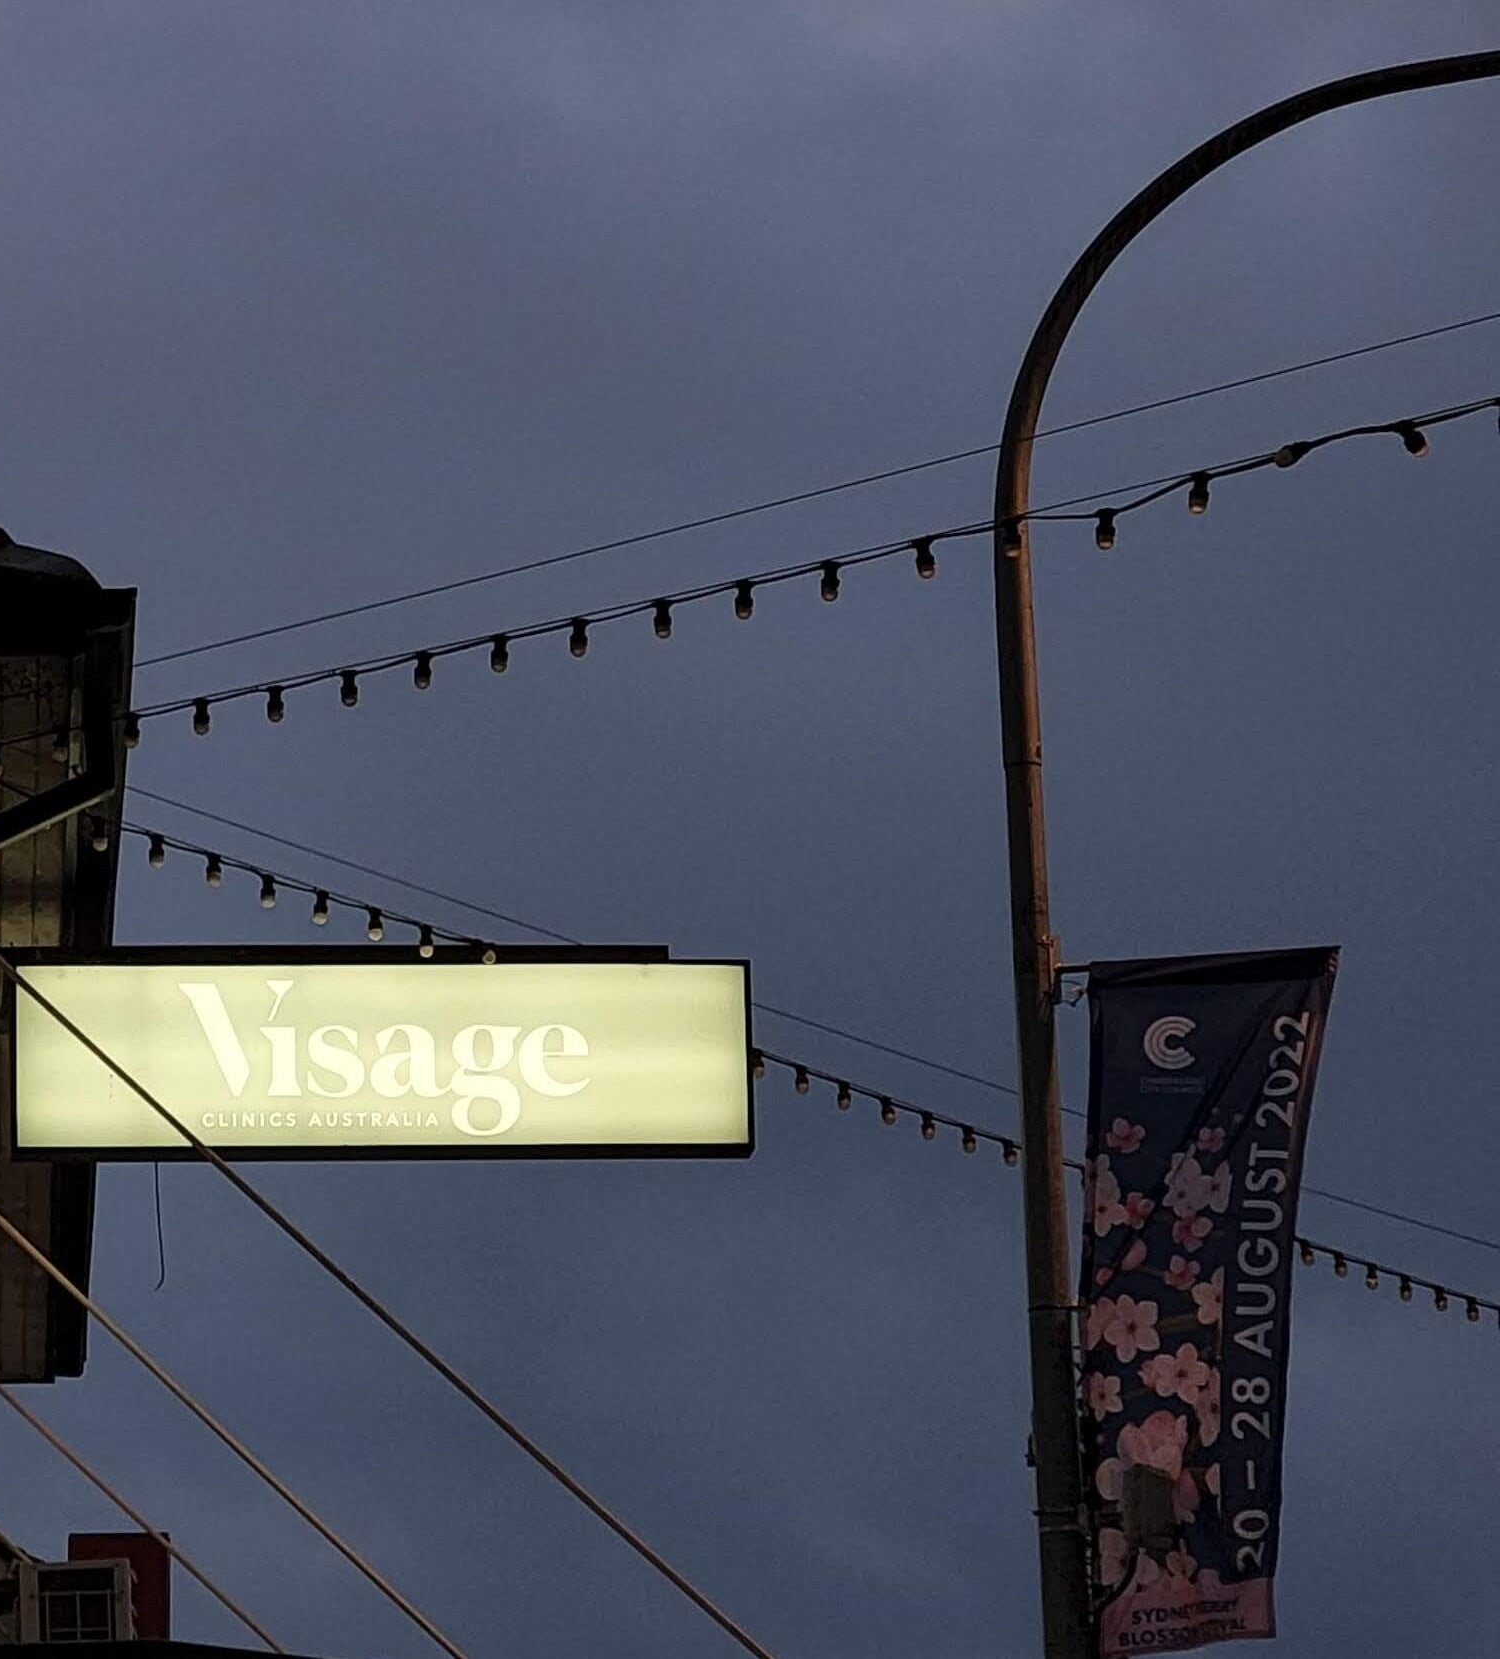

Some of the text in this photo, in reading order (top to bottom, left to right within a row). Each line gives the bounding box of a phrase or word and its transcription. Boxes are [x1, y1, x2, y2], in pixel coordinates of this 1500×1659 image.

[1254, 1010, 1310, 1129] 2022
[201, 1112, 440, 1128] CLINICS AUSTRALIA
[1233, 1141, 1289, 1360] AUGUST
[1231, 1376, 1271, 1440] 28
[1233, 1508, 1270, 1572] 20
